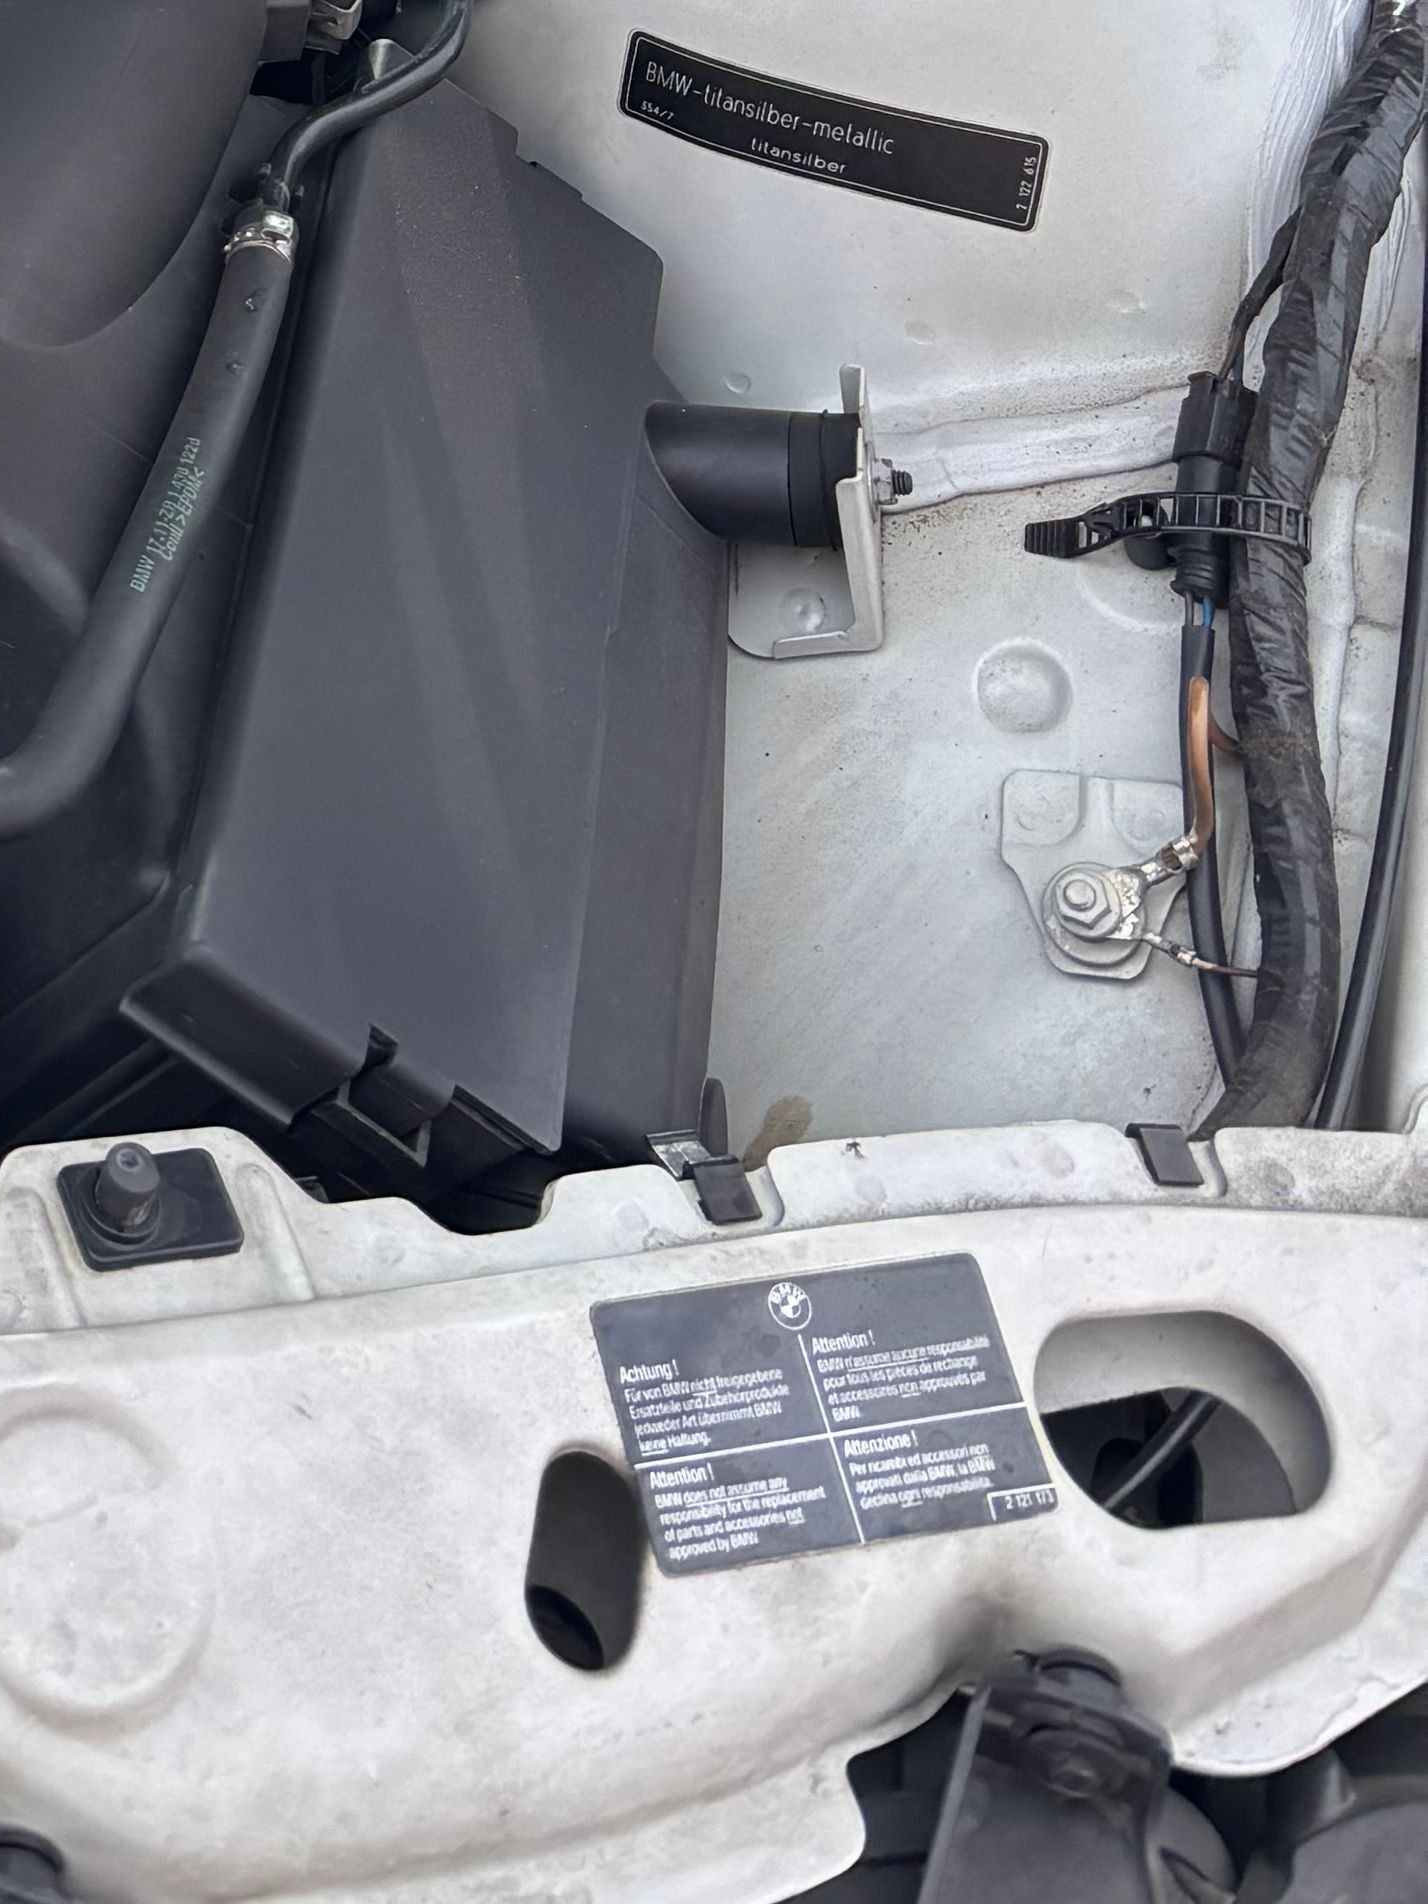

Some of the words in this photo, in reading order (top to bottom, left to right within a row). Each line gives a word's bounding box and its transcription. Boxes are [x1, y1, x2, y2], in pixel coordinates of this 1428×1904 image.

[645, 61, 895, 156] BMW-titansilber-metallic
[750, 137, 846, 175] titansilber
[130, 554, 156, 593] BMW
[811, 1332, 869, 1356] Attention
[619, 1363, 673, 1385] Achtung
[843, 1433, 912, 1458] Attenzione
[649, 1466, 708, 1490] Attention
[654, 1491, 683, 1509] BMW
